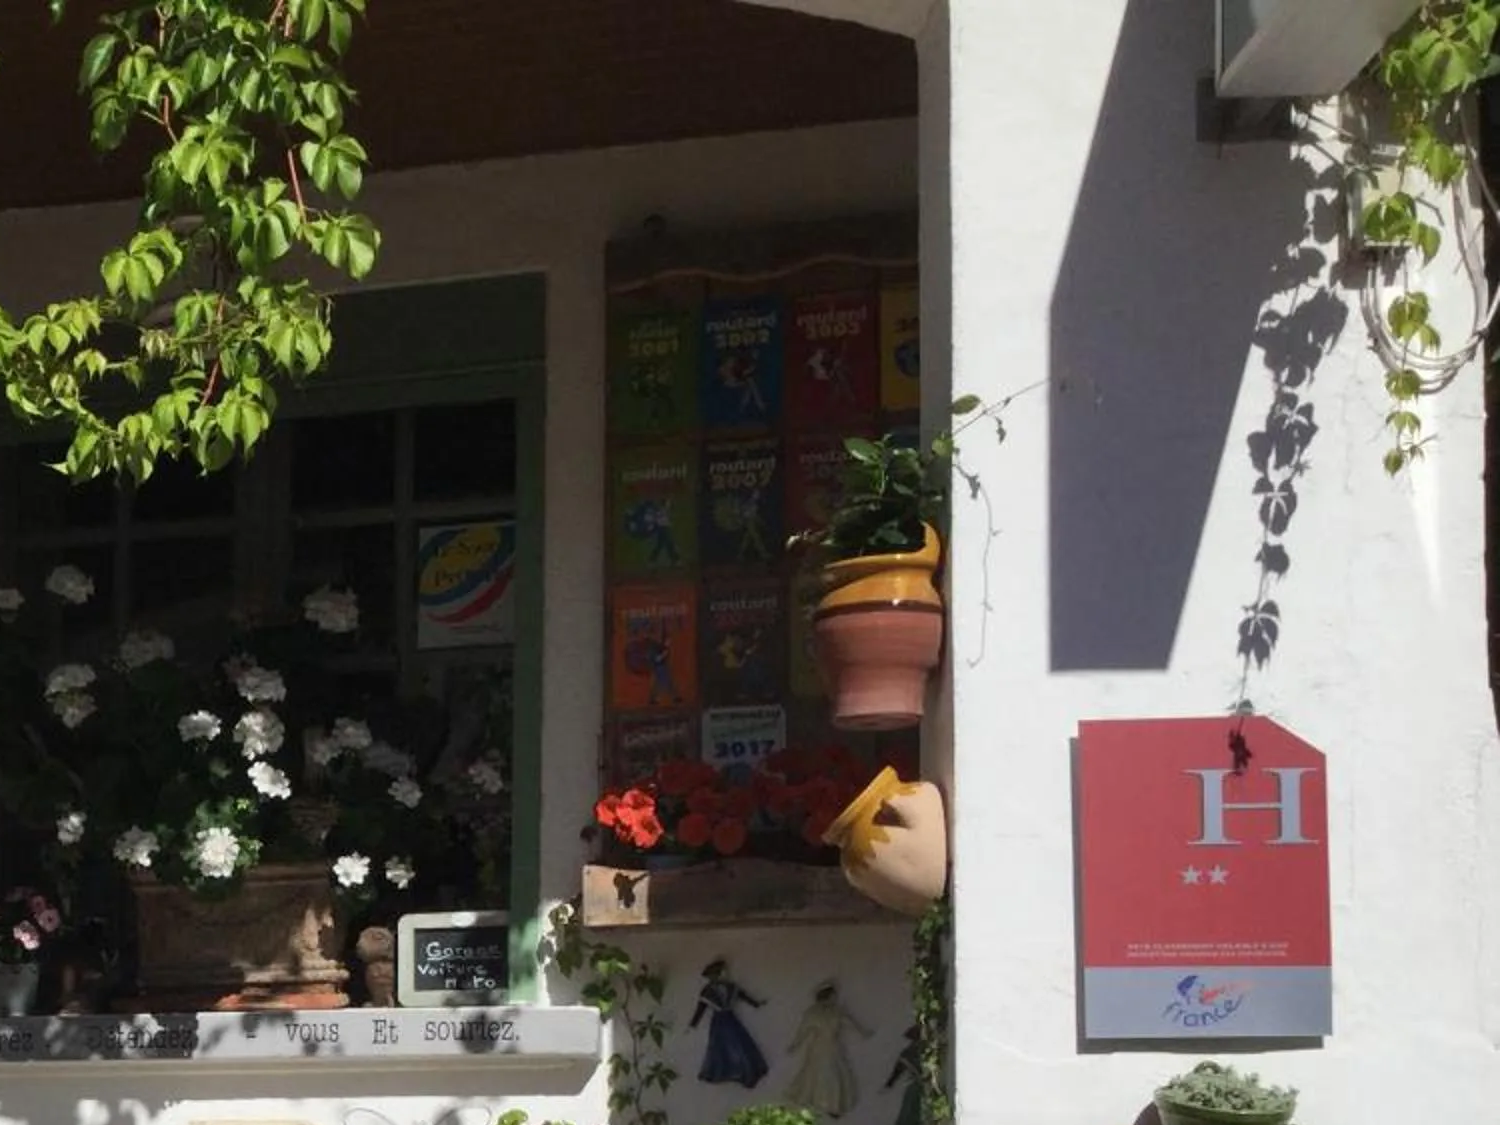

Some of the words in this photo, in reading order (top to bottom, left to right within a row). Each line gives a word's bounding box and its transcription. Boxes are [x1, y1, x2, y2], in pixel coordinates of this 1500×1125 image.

[708, 454, 777, 474] routard
[715, 739, 775, 758] 2017
[1182, 767, 1319, 845] H
[285, 1022, 340, 1043] vous
[372, 1018, 399, 1044] Et
